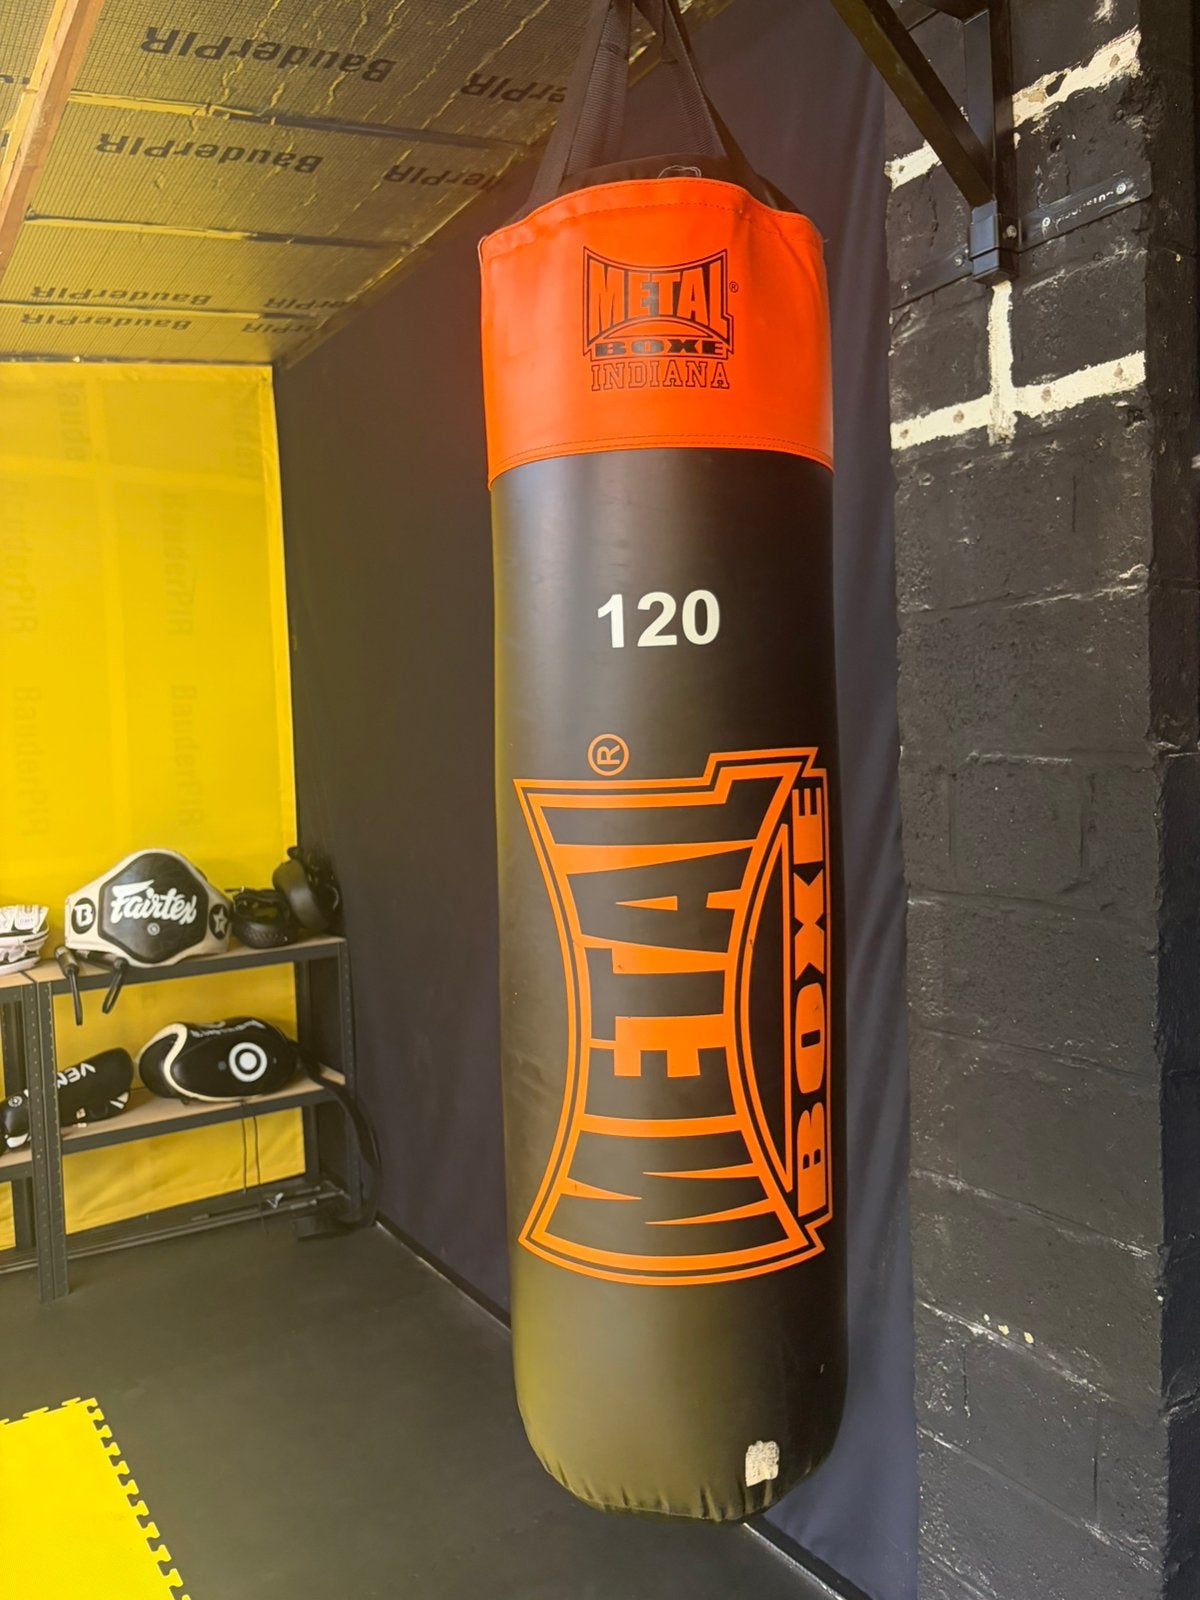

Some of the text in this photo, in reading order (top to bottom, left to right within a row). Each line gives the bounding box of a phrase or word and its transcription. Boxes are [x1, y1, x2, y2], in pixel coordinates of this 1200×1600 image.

[141, 27, 396, 83] BauderPIR
[96, 133, 323, 173] BauderPIR
[31, 286, 212, 305] BauderPIR
[587, 254, 731, 347] METAL
[20, 313, 192, 330] BauderPIR
[595, 339, 723, 357] BOXE
[591, 360, 730, 391] INDIANA
[597, 590, 720, 648] 120
[110, 879, 197, 925] Fairtex
[538, 775, 826, 1257] METAL BOXE
